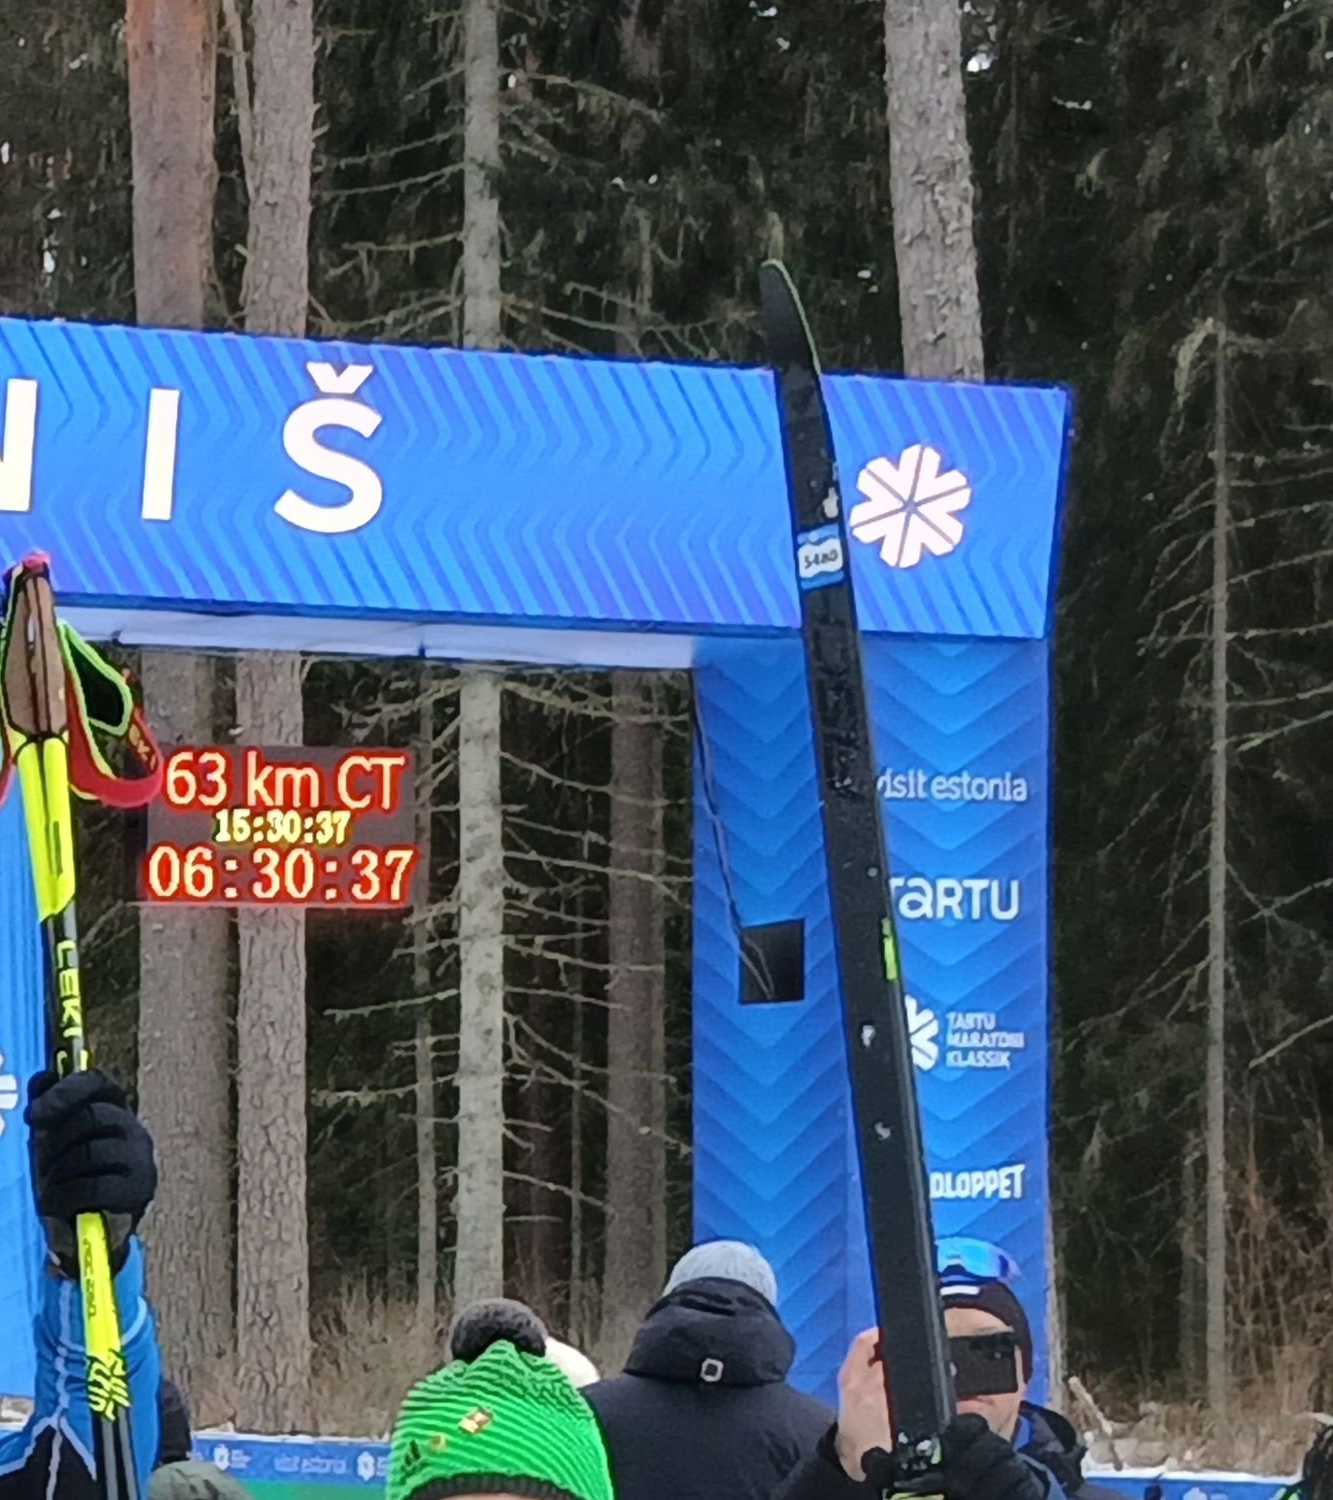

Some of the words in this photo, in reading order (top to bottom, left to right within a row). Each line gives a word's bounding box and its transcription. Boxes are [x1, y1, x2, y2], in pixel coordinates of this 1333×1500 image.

[165, 752, 228, 807] 63
[246, 754, 320, 807] km
[336, 756, 405, 809] CT
[931, 770, 1027, 801] estonia
[215, 809, 351, 844] 15:30:37
[148, 847, 415, 901] 06:30:37
[948, 1012, 996, 1030] TARTU
